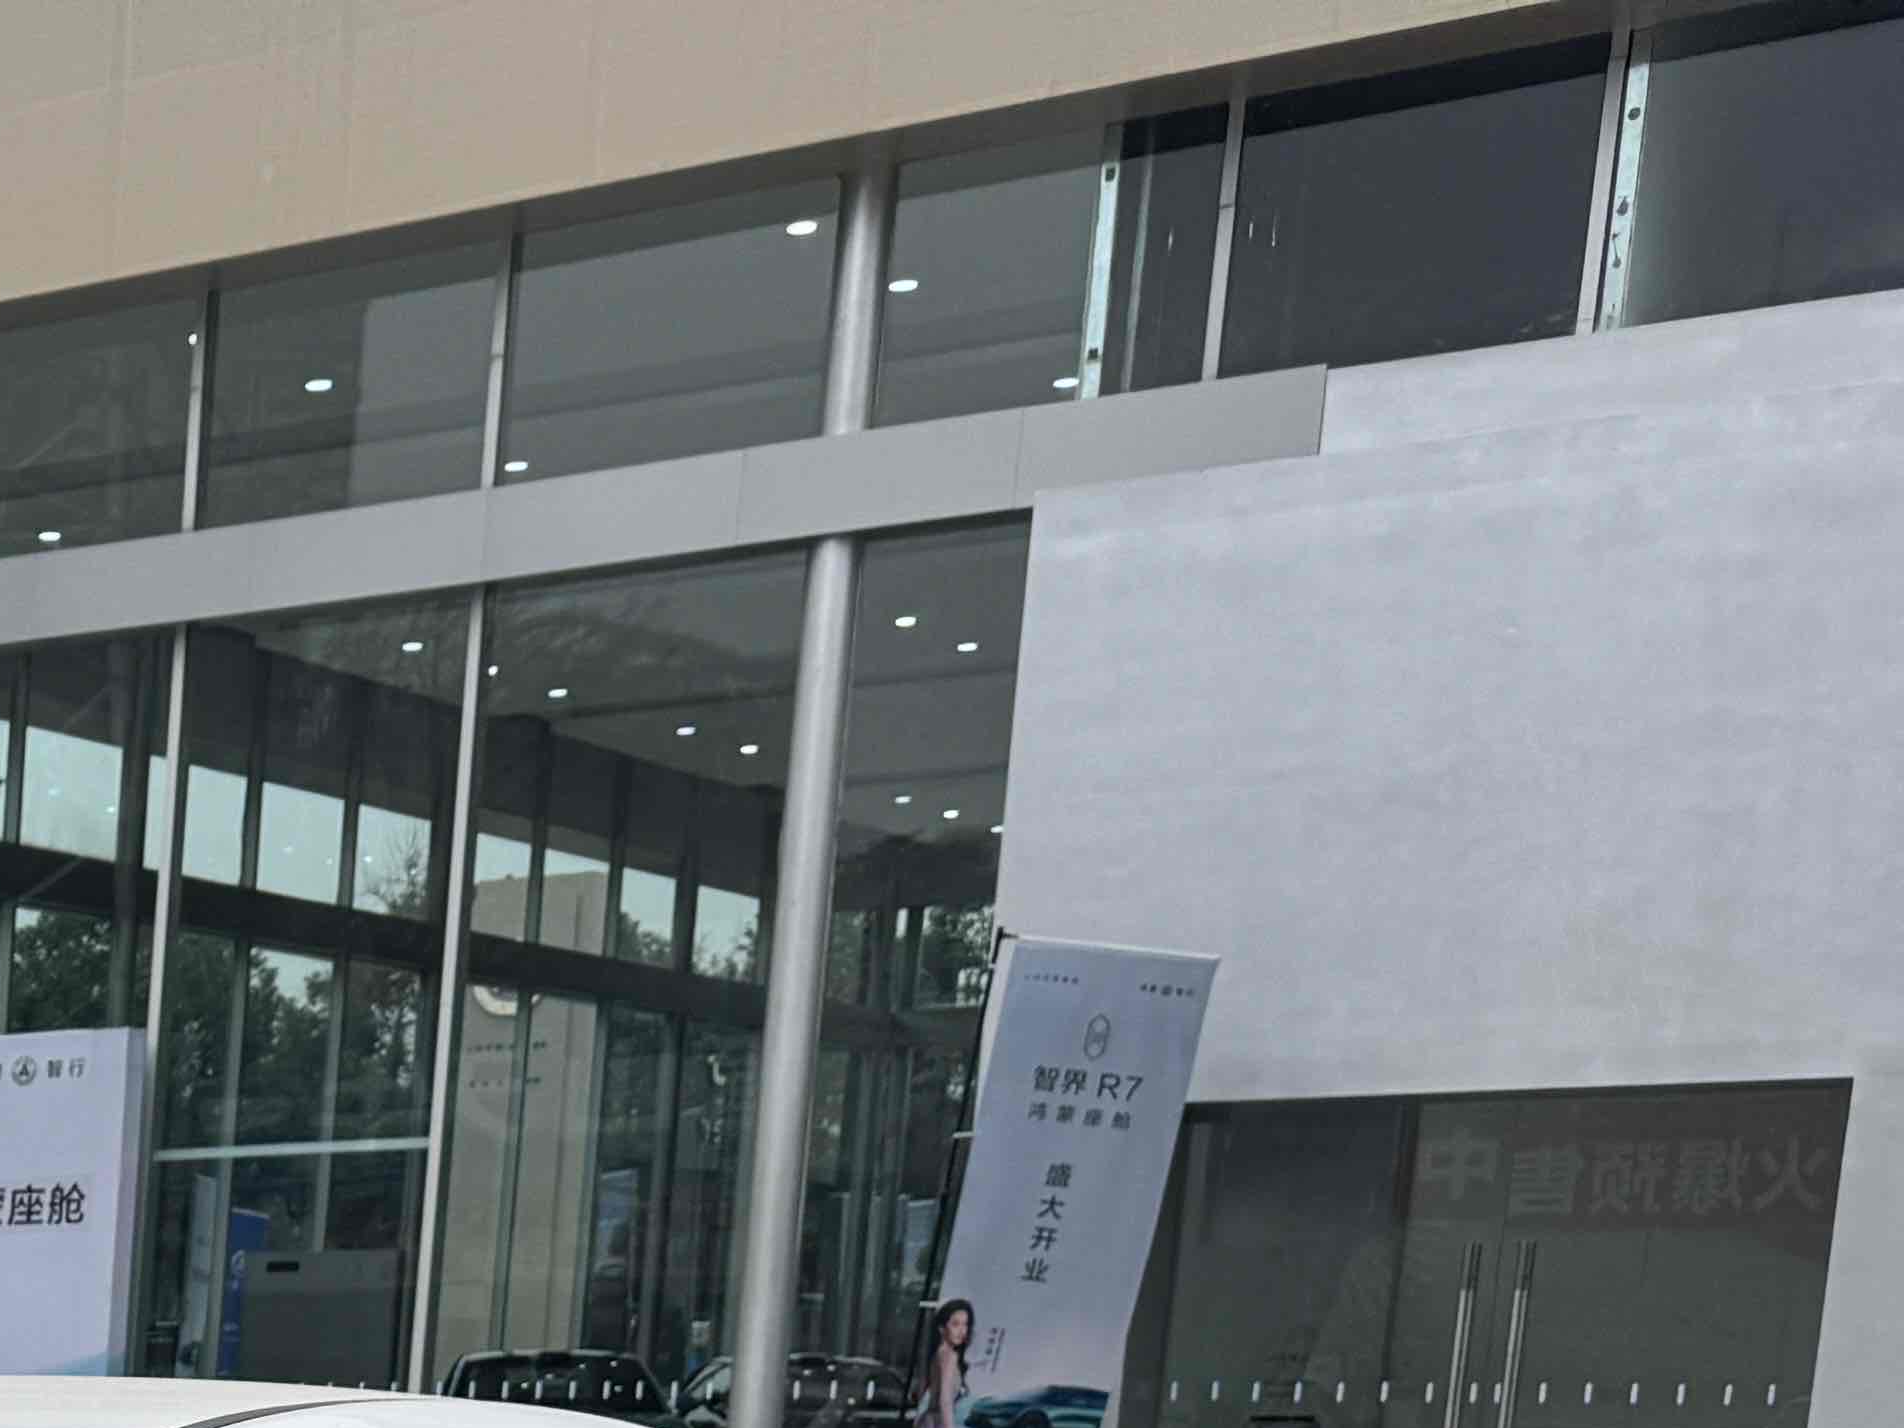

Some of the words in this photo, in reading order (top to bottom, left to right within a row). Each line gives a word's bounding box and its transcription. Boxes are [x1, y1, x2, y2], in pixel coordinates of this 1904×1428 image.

[1033, 1064, 1088, 1096] 智界
[1096, 1072, 1144, 1102] R7
[1021, 1162, 1074, 1284] 盛大开业
